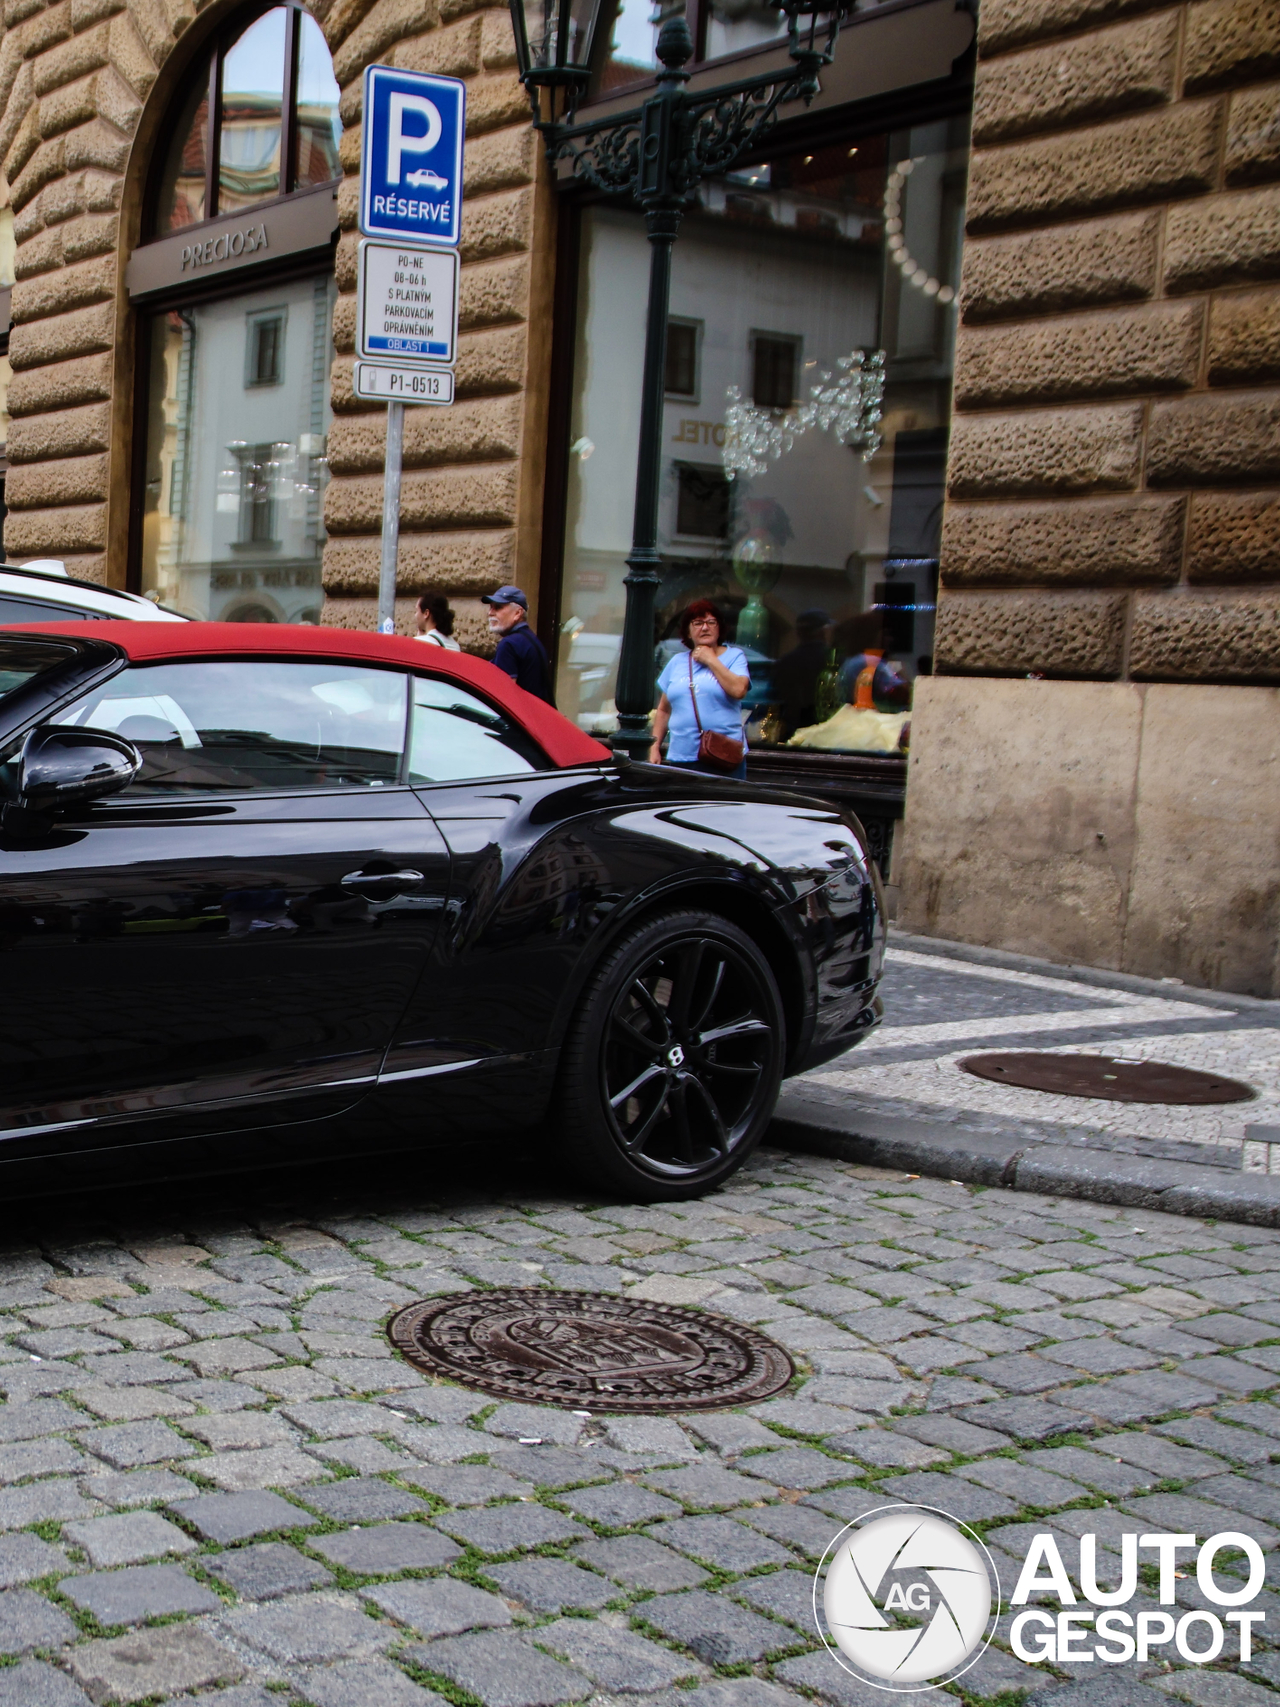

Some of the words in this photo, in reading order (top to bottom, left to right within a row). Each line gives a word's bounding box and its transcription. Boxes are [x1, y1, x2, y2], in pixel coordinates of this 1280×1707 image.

[386, 91, 442, 186] P
[374, 193, 451, 222] RÉSERVÉ
[180, 223, 269, 271] PRECIOSA
[398, 255, 424, 269] PO-NE
[394, 271, 419, 285] 08-06
[421, 274, 427, 286] h
[388, 288, 394, 299] S
[396, 289, 432, 303] PLATNÝM
[384, 304, 434, 320] PARKOVACÍM
[383, 320, 434, 337] OPRÁVNĚNÍM
[387, 339, 424, 352] OBLAST
[390, 374, 440, 395] P1-0513
